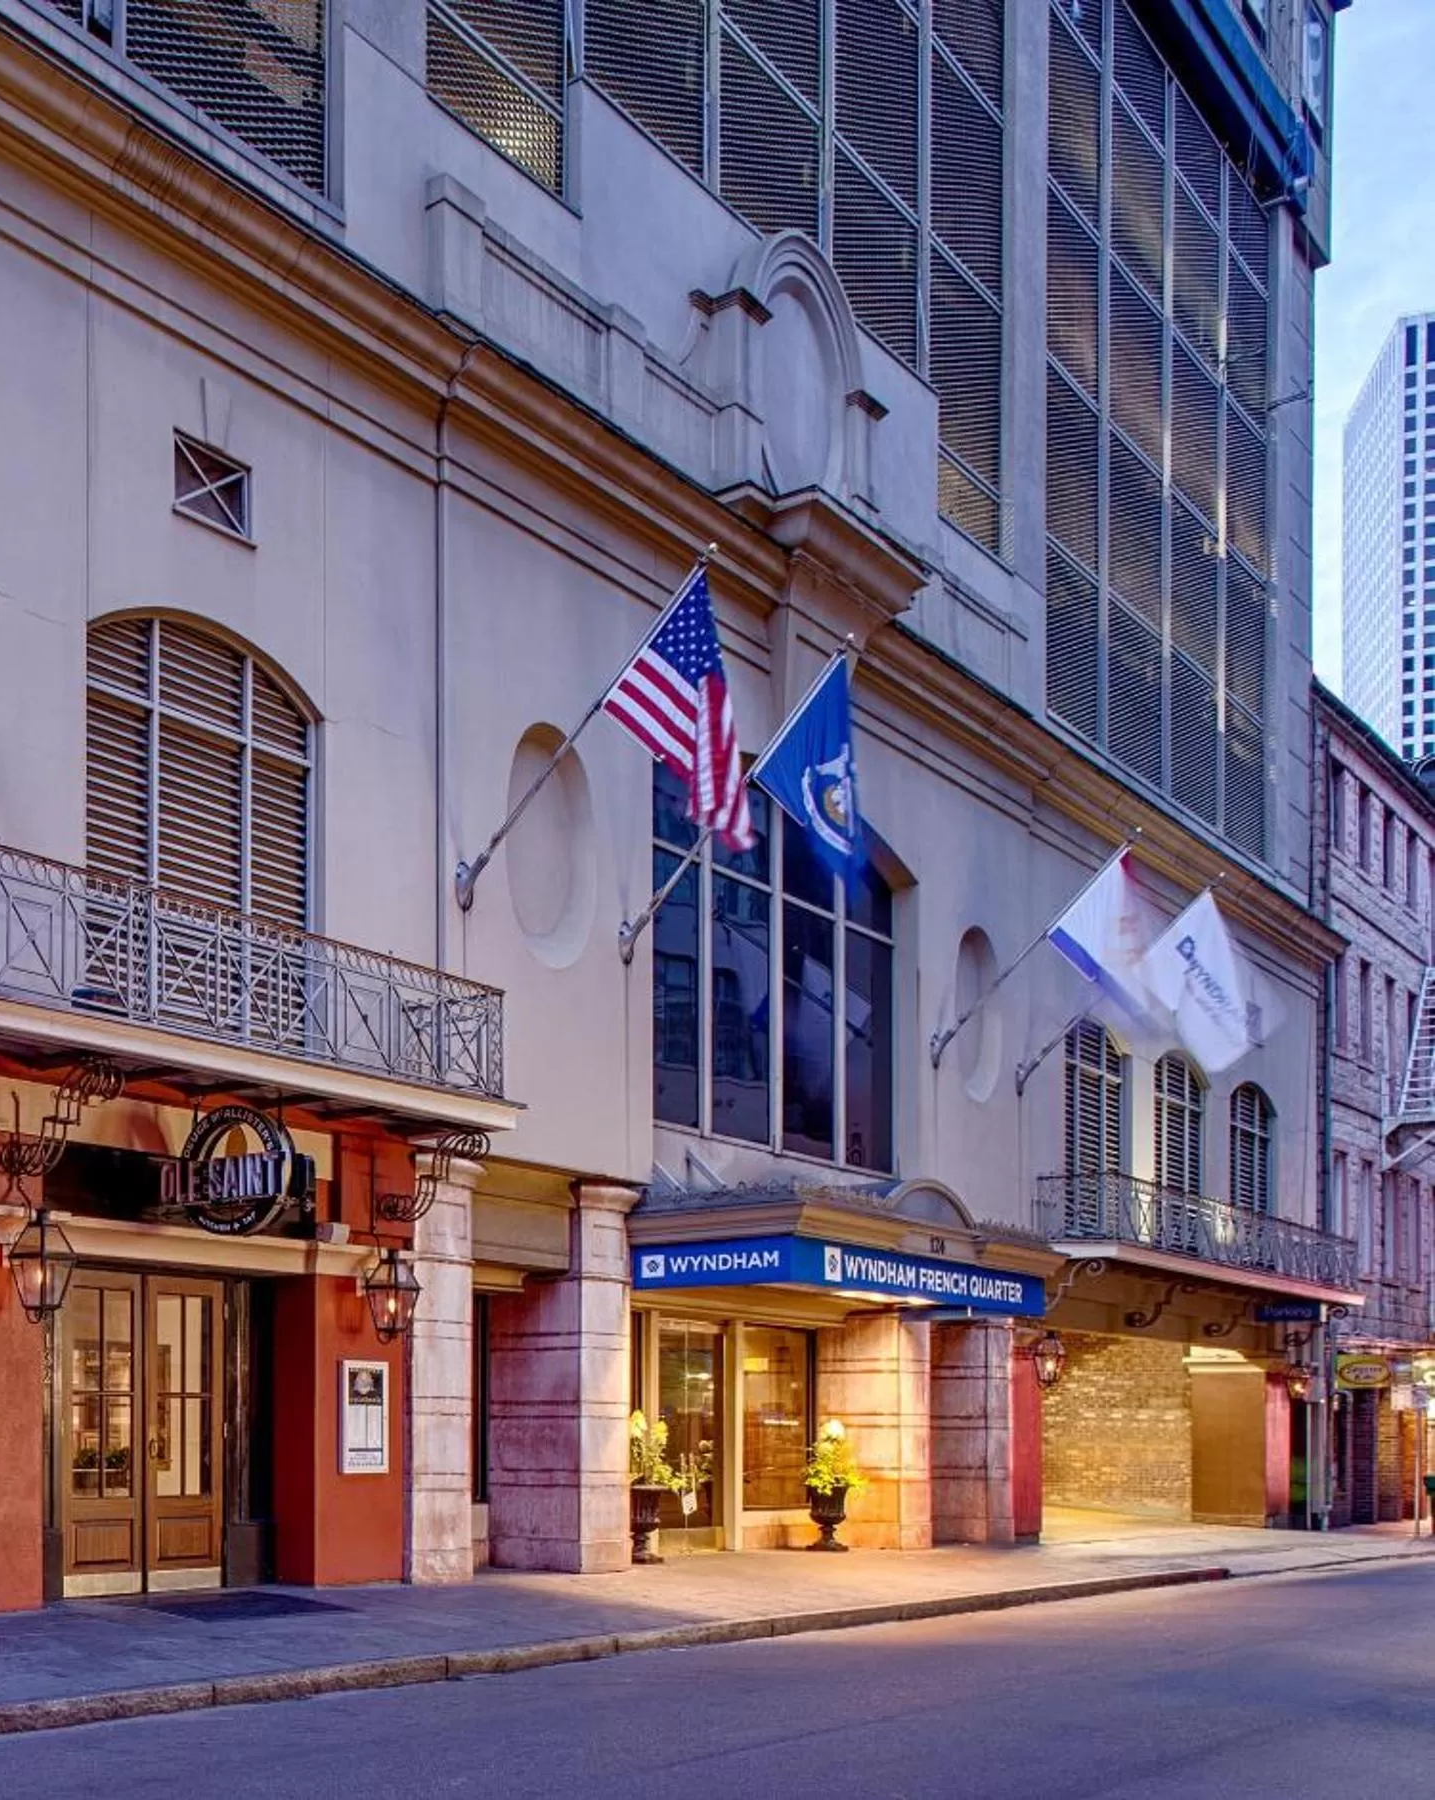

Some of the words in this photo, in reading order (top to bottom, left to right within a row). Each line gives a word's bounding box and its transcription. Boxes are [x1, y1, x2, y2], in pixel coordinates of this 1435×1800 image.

[183, 1118, 210, 1158] DEUCE
[160, 1158, 200, 1203] OLE
[209, 1152, 279, 1200] SAINT
[669, 1250, 780, 1274] WYNDHAM
[844, 1254, 916, 1289] WYNDHAM
[919, 1267, 968, 1296] FRENCH
[969, 1276, 1023, 1304] QUARTER
[1264, 1304, 1313, 1318] Parking
